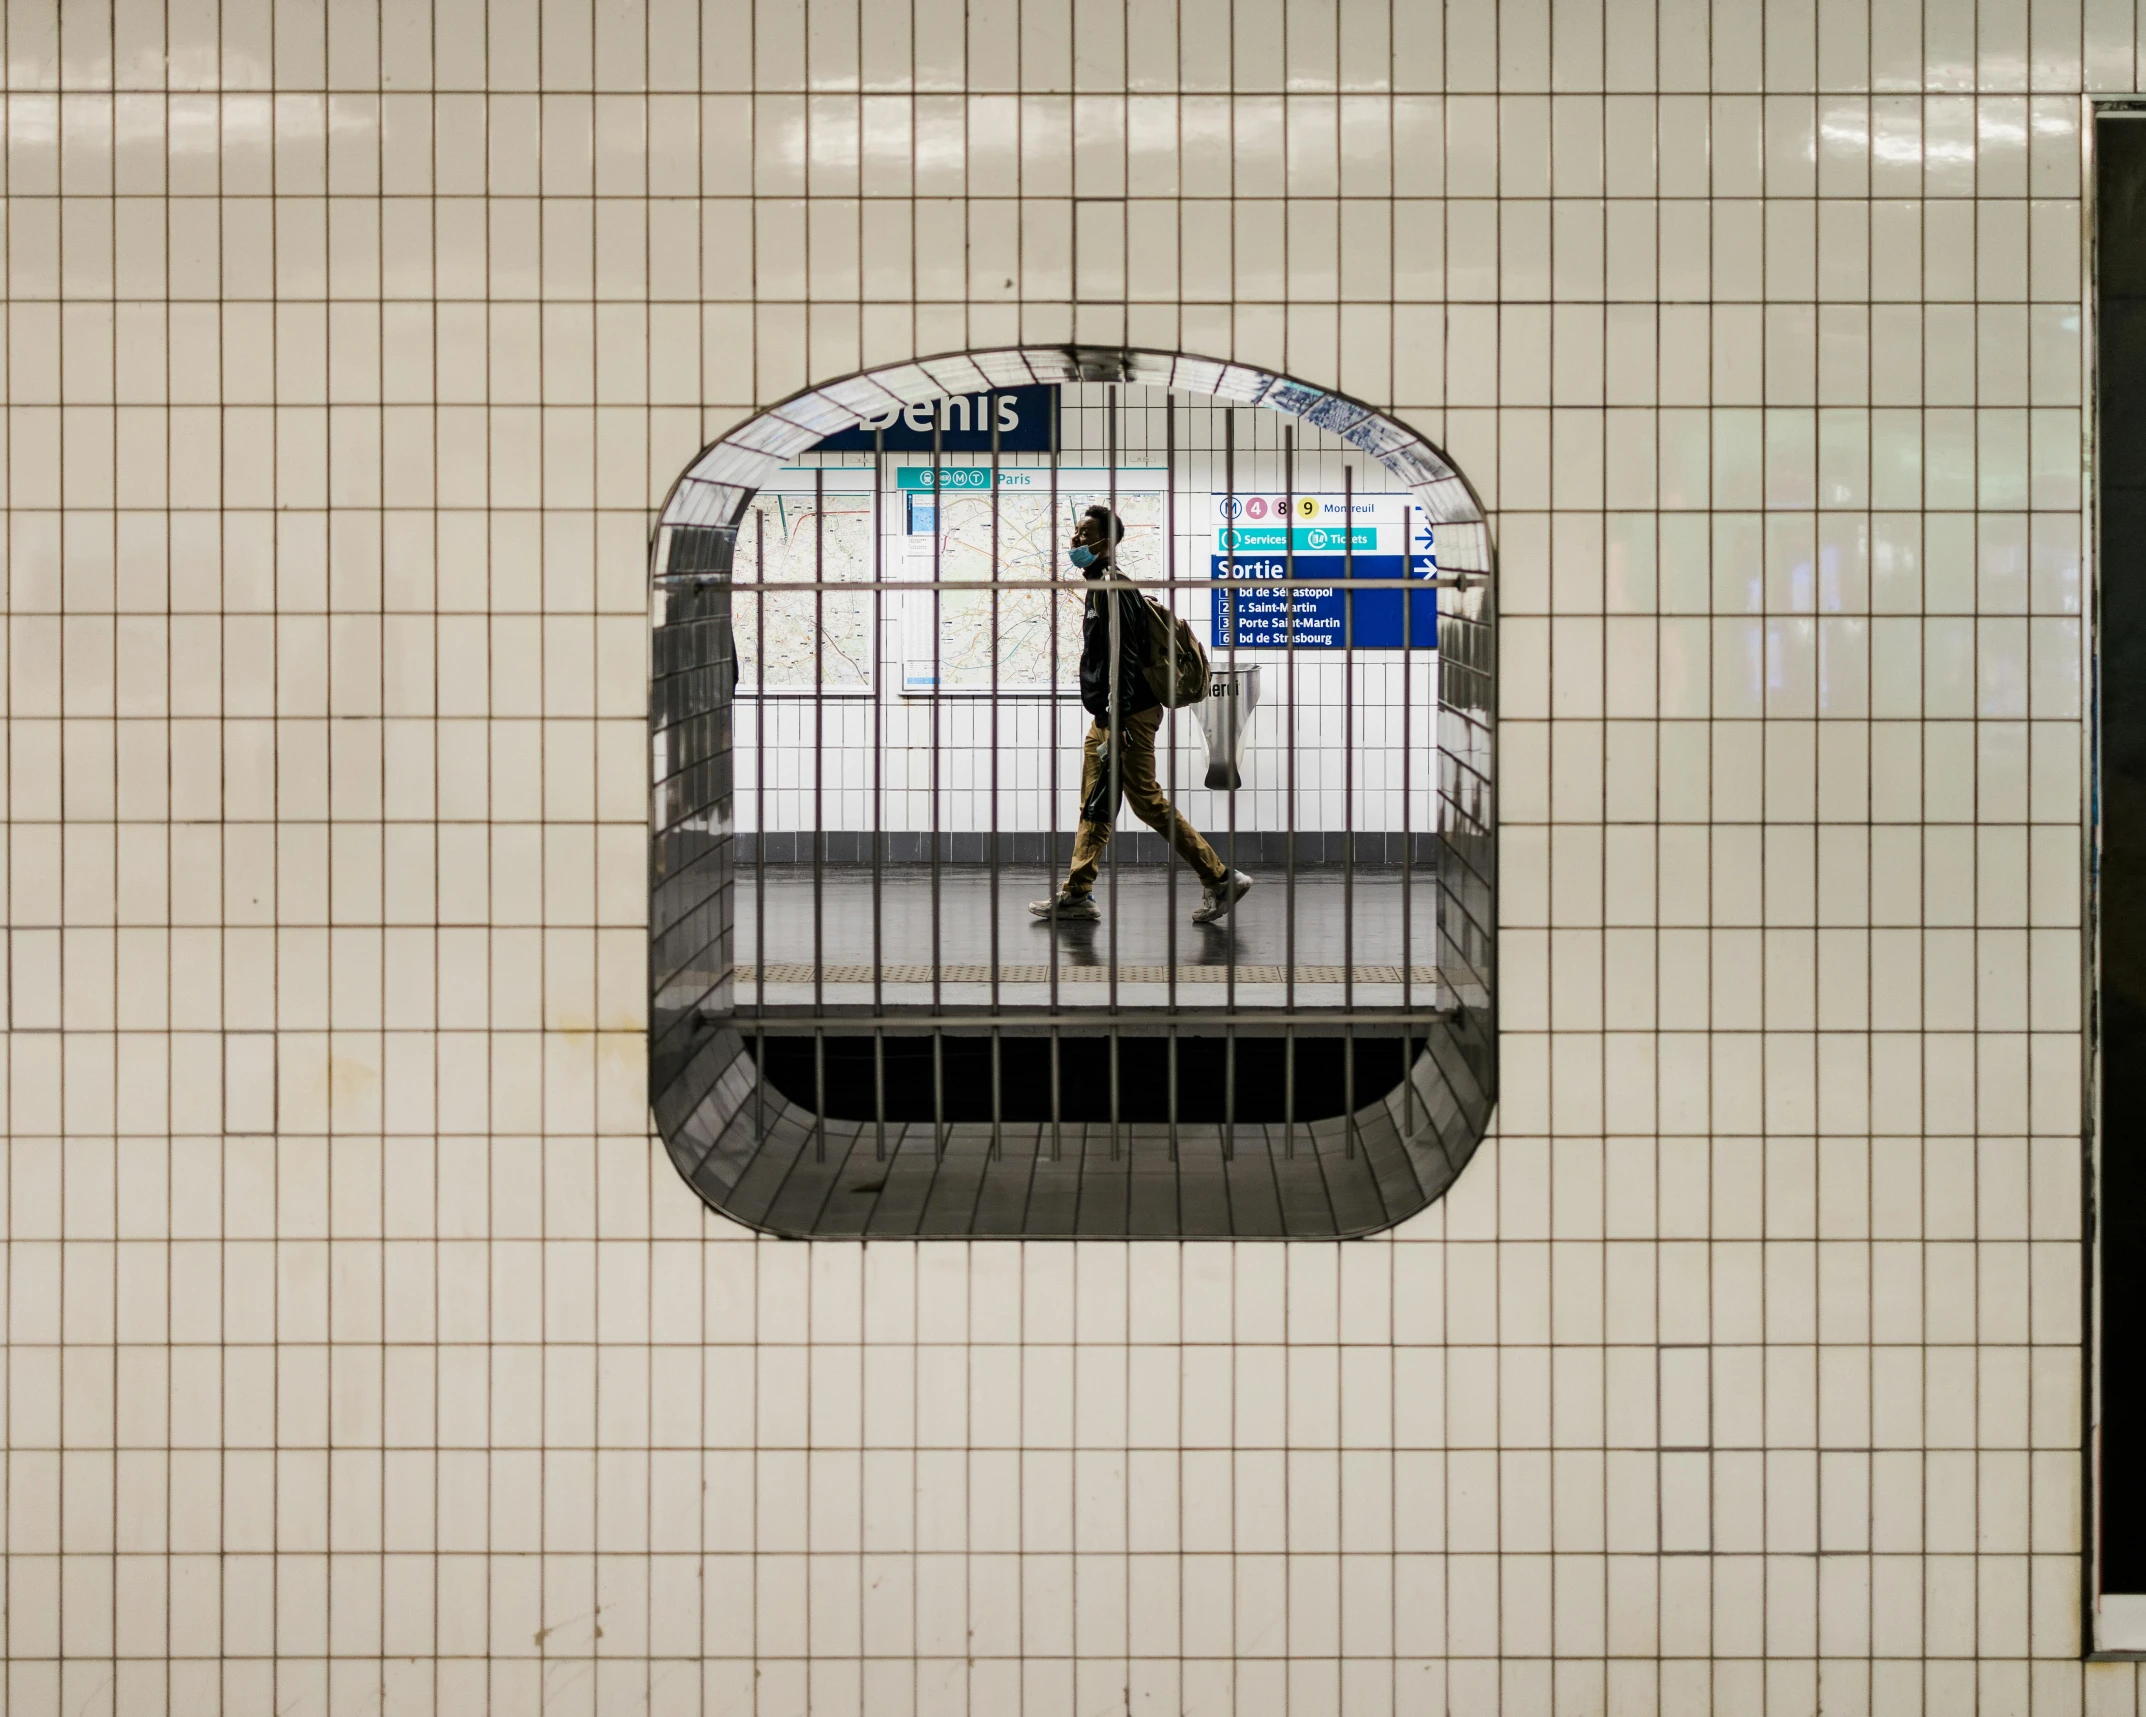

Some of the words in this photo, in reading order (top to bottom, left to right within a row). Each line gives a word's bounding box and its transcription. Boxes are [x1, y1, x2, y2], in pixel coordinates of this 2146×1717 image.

[998, 473, 1030, 484] Paris
[1250, 501, 1262, 515] 4
[1278, 501, 1287, 515] 8
[1303, 501, 1313, 515] 9
[1324, 504, 1374, 512] Monreuil
[1244, 534, 1287, 544] Services
[1330, 534, 1368, 544] Ticets
[1218, 560, 1284, 579] Sortie
[1239, 587, 1253, 597] bd
[1256, 587, 1270, 597] de
[1222, 603, 1230, 612] 2
[1239, 604, 1246, 612] r.
[1222, 618, 1230, 628] 3
[1239, 618, 1269, 628] Porte
[1222, 633, 1230, 643] 6
[1239, 633, 1253, 643] bd
[1256, 633, 1270, 643] de
[1208, 680, 1239, 697] eri
